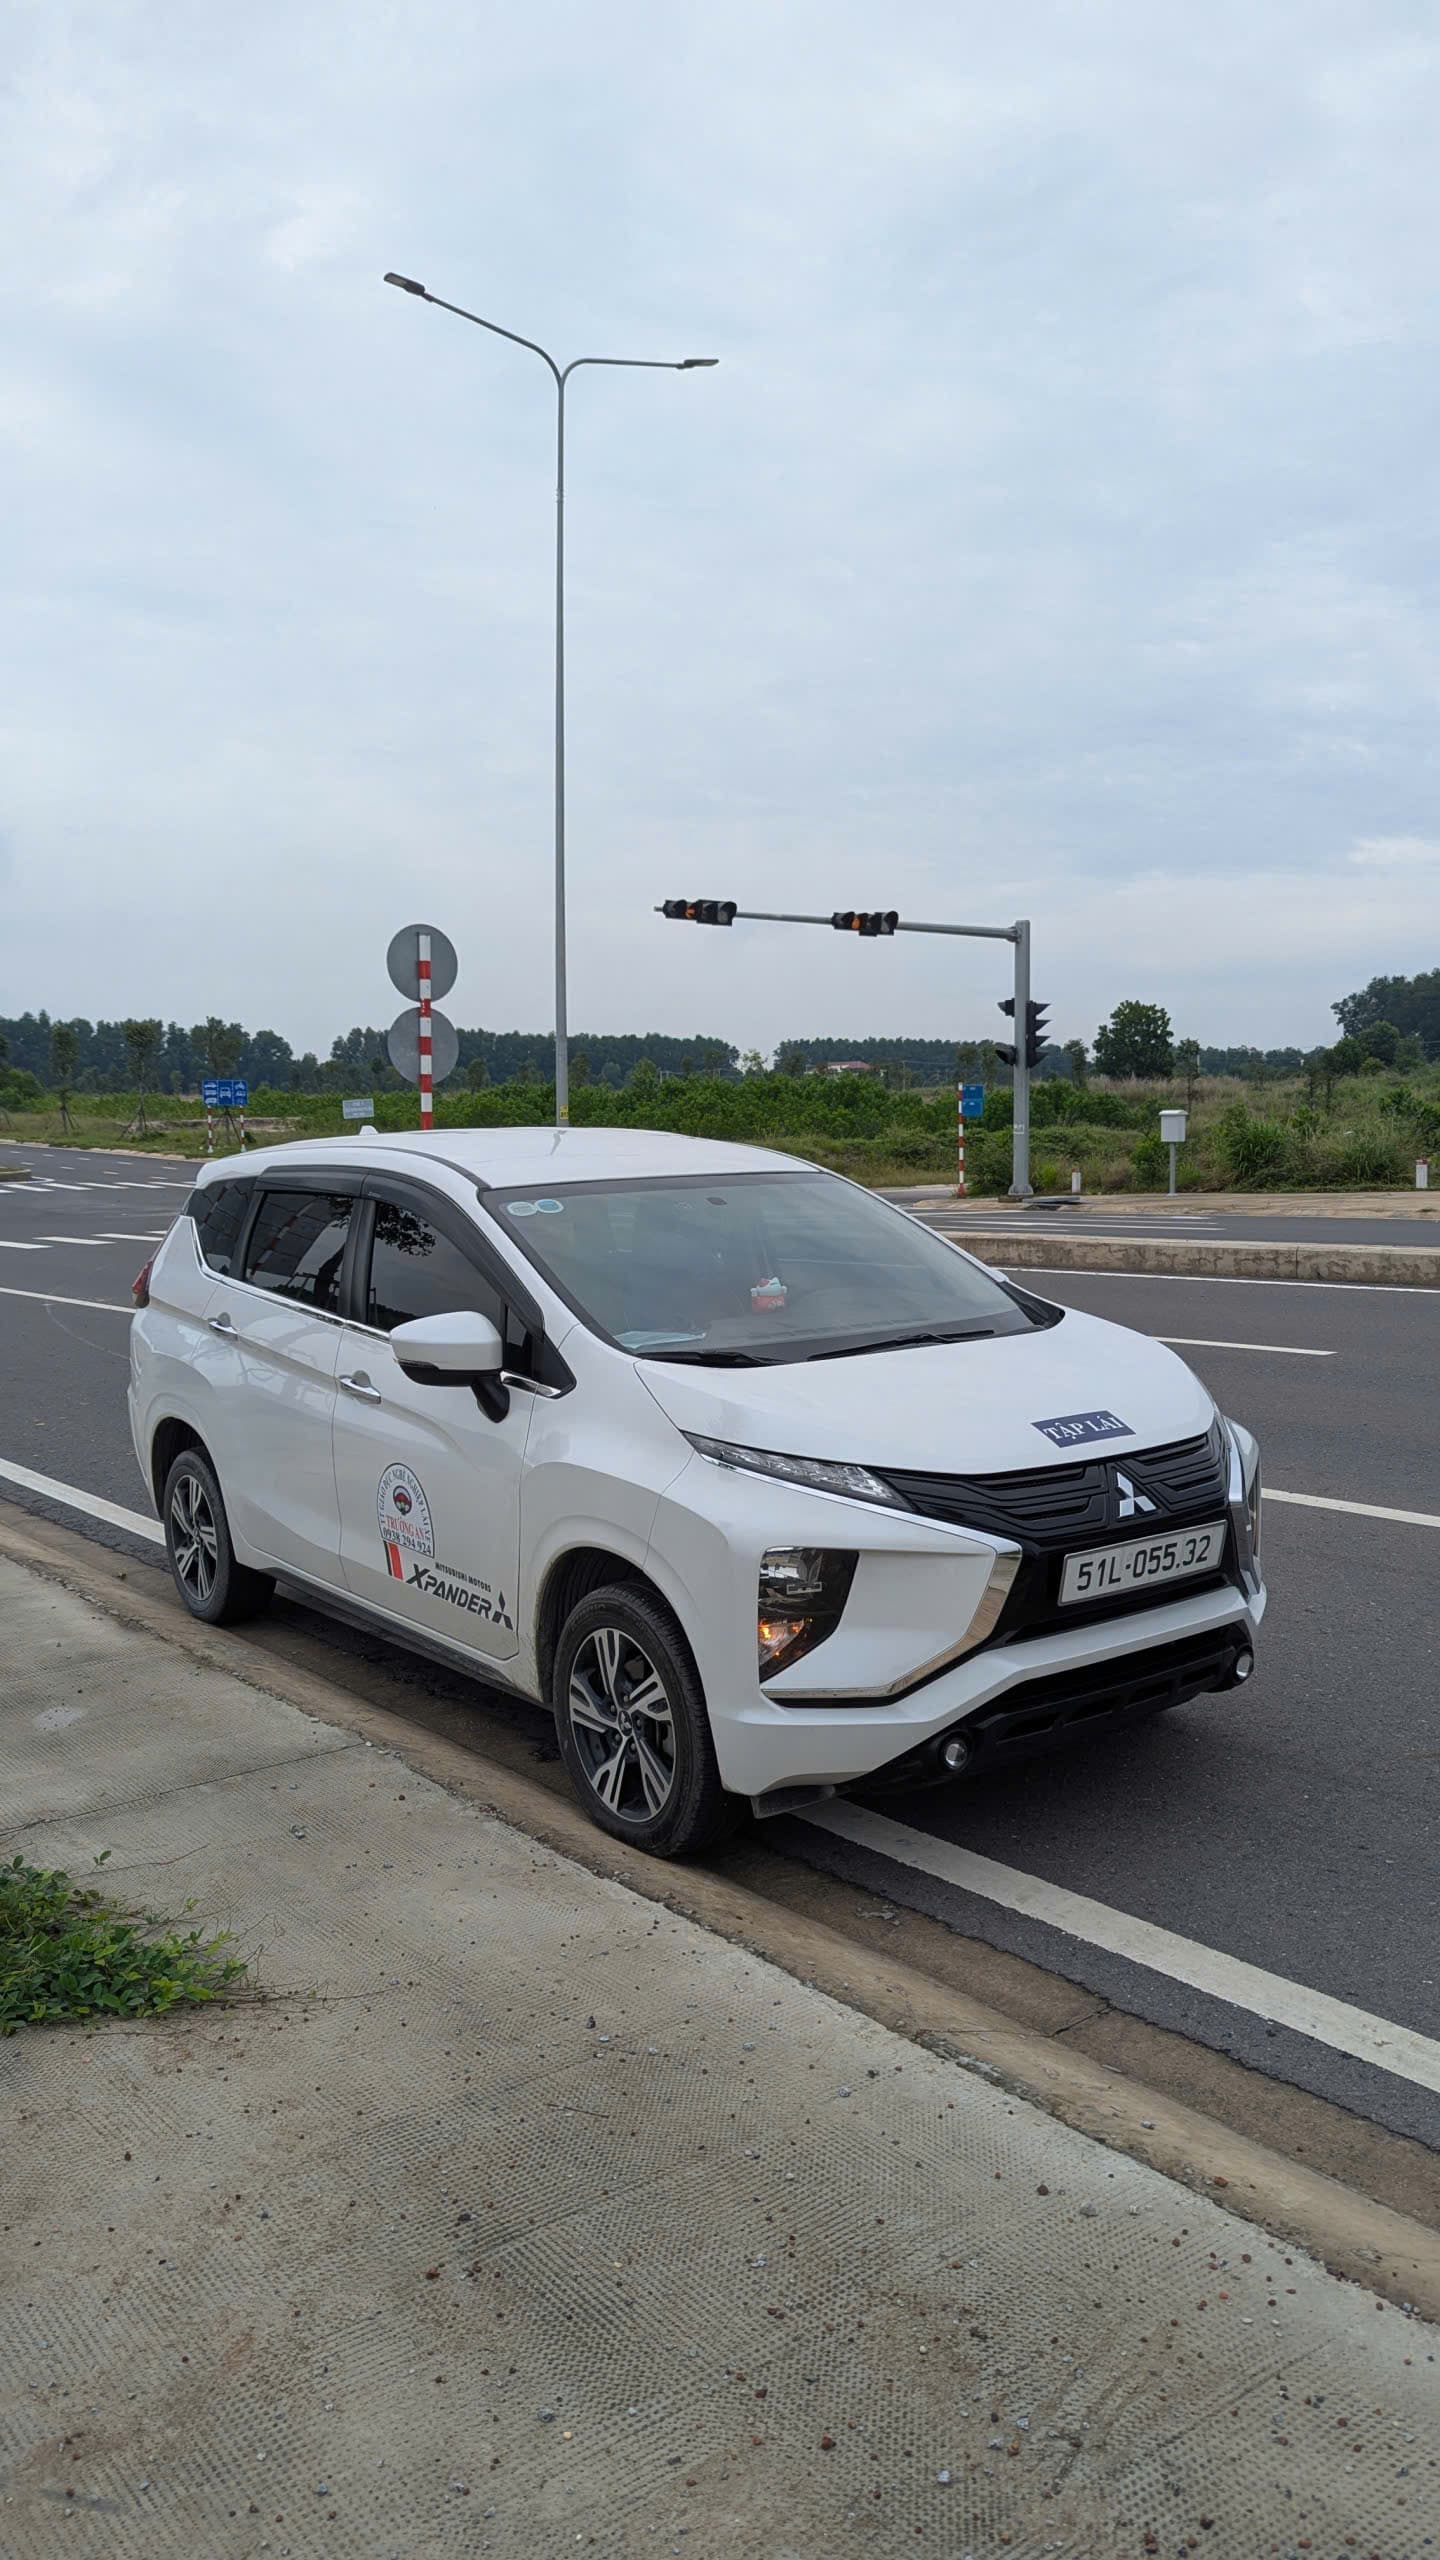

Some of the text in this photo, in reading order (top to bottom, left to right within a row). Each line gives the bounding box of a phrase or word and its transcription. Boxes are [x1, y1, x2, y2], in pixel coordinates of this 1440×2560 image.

[1042, 1415, 1125, 1440] TẬP LÁI
[383, 1527, 432, 1554] 0938 294 924
[406, 1563, 493, 1619] XPANDER
[435, 1562, 491, 1593] MITSUBISHI MOTORS
